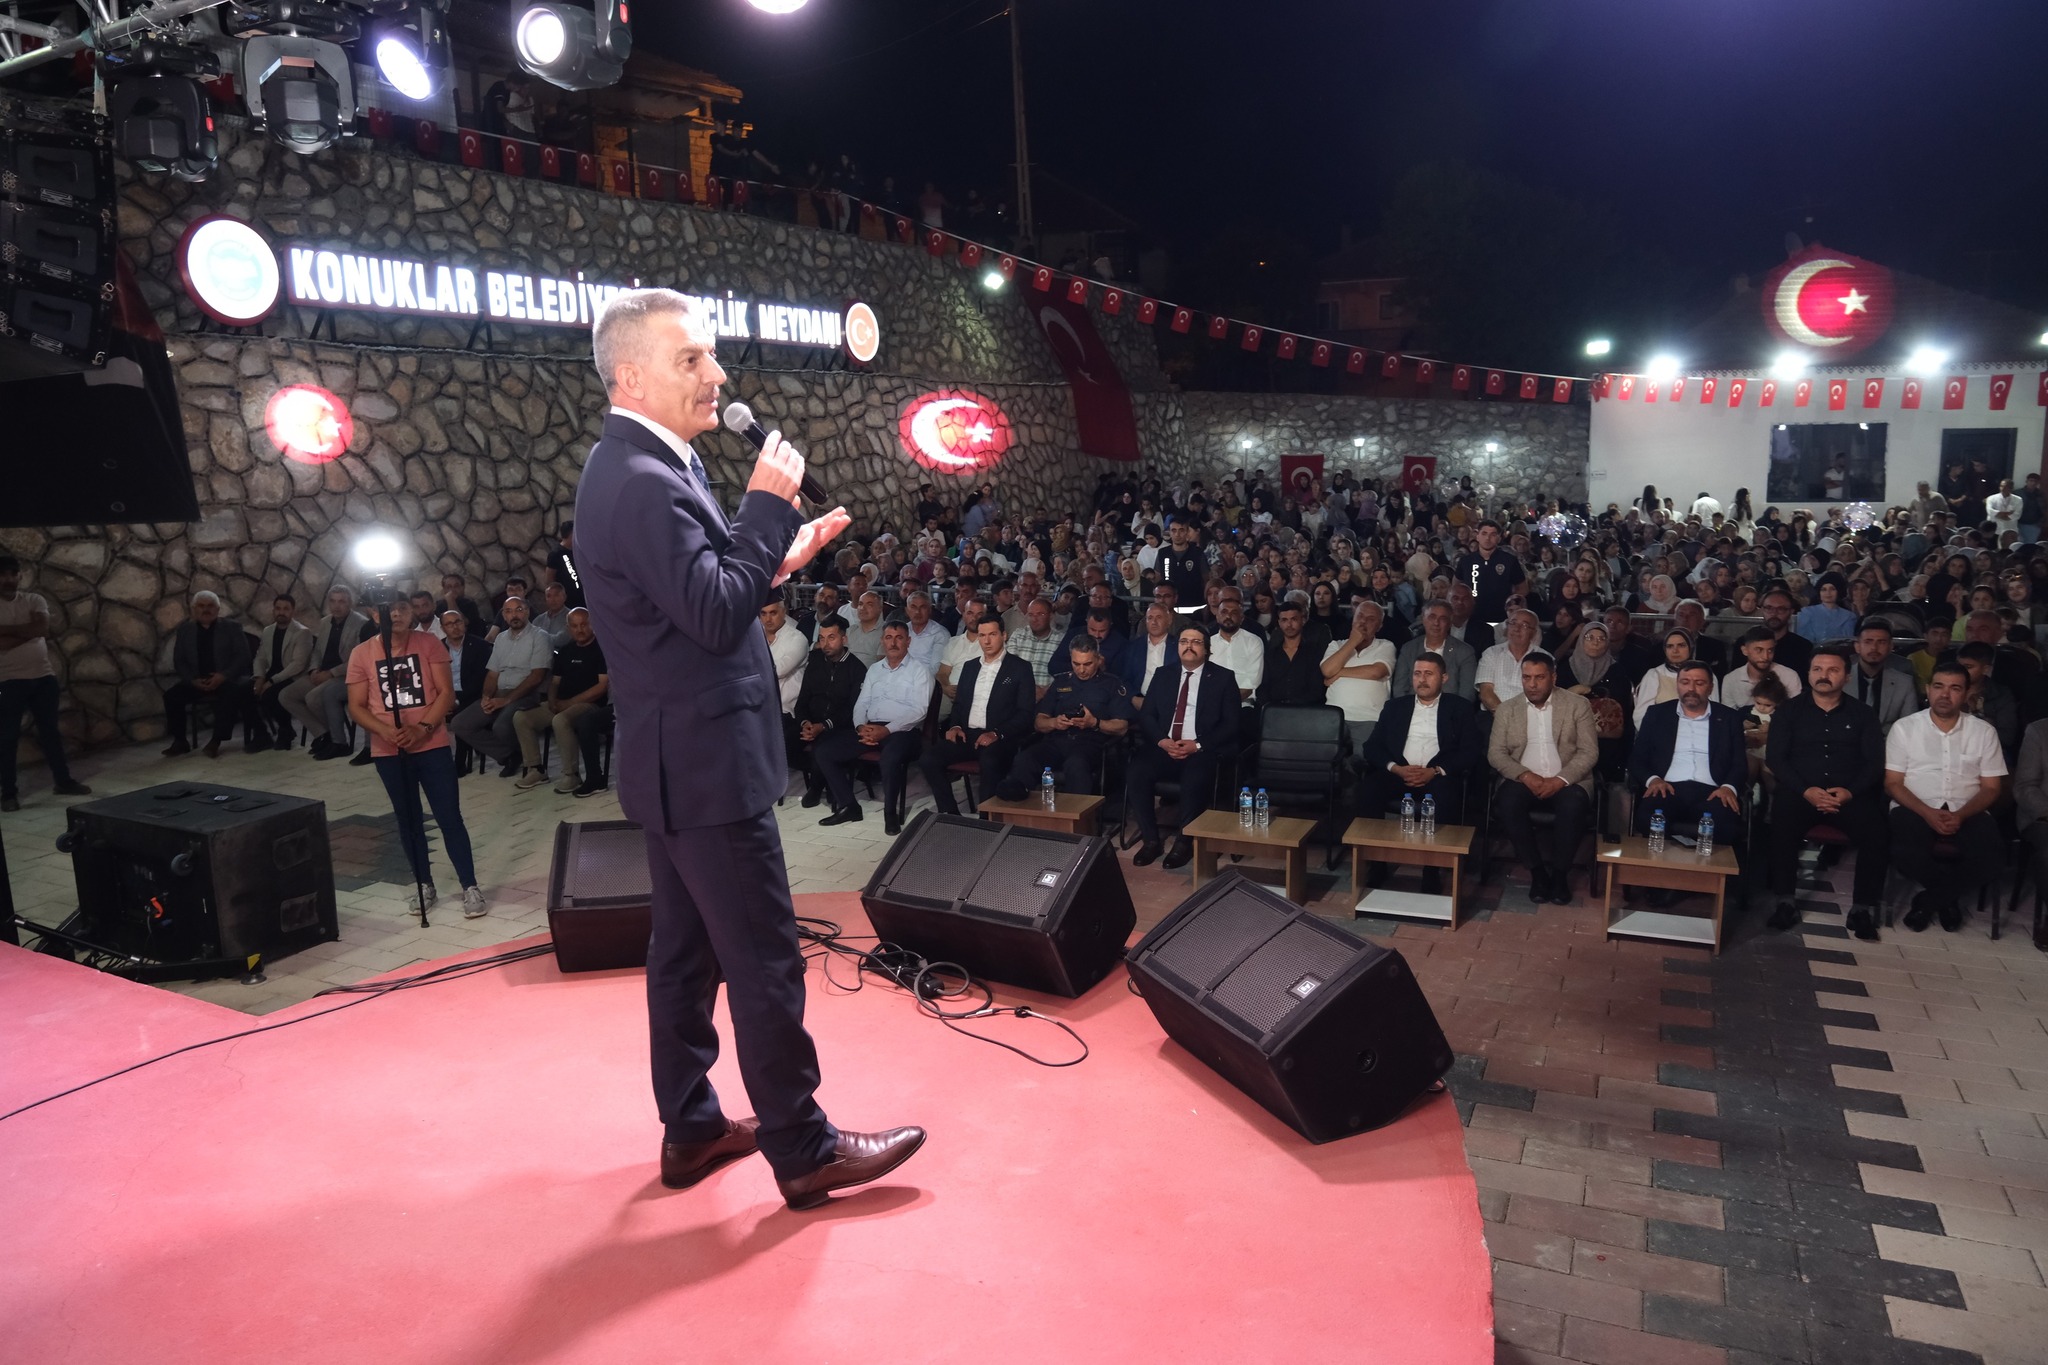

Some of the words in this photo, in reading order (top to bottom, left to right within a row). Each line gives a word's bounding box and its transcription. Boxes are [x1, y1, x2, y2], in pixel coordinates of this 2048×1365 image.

[291, 247, 479, 315] KONUKLAR
[487, 271, 640, 325] BELEDİY
[758, 303, 842, 346] MEYDANI
